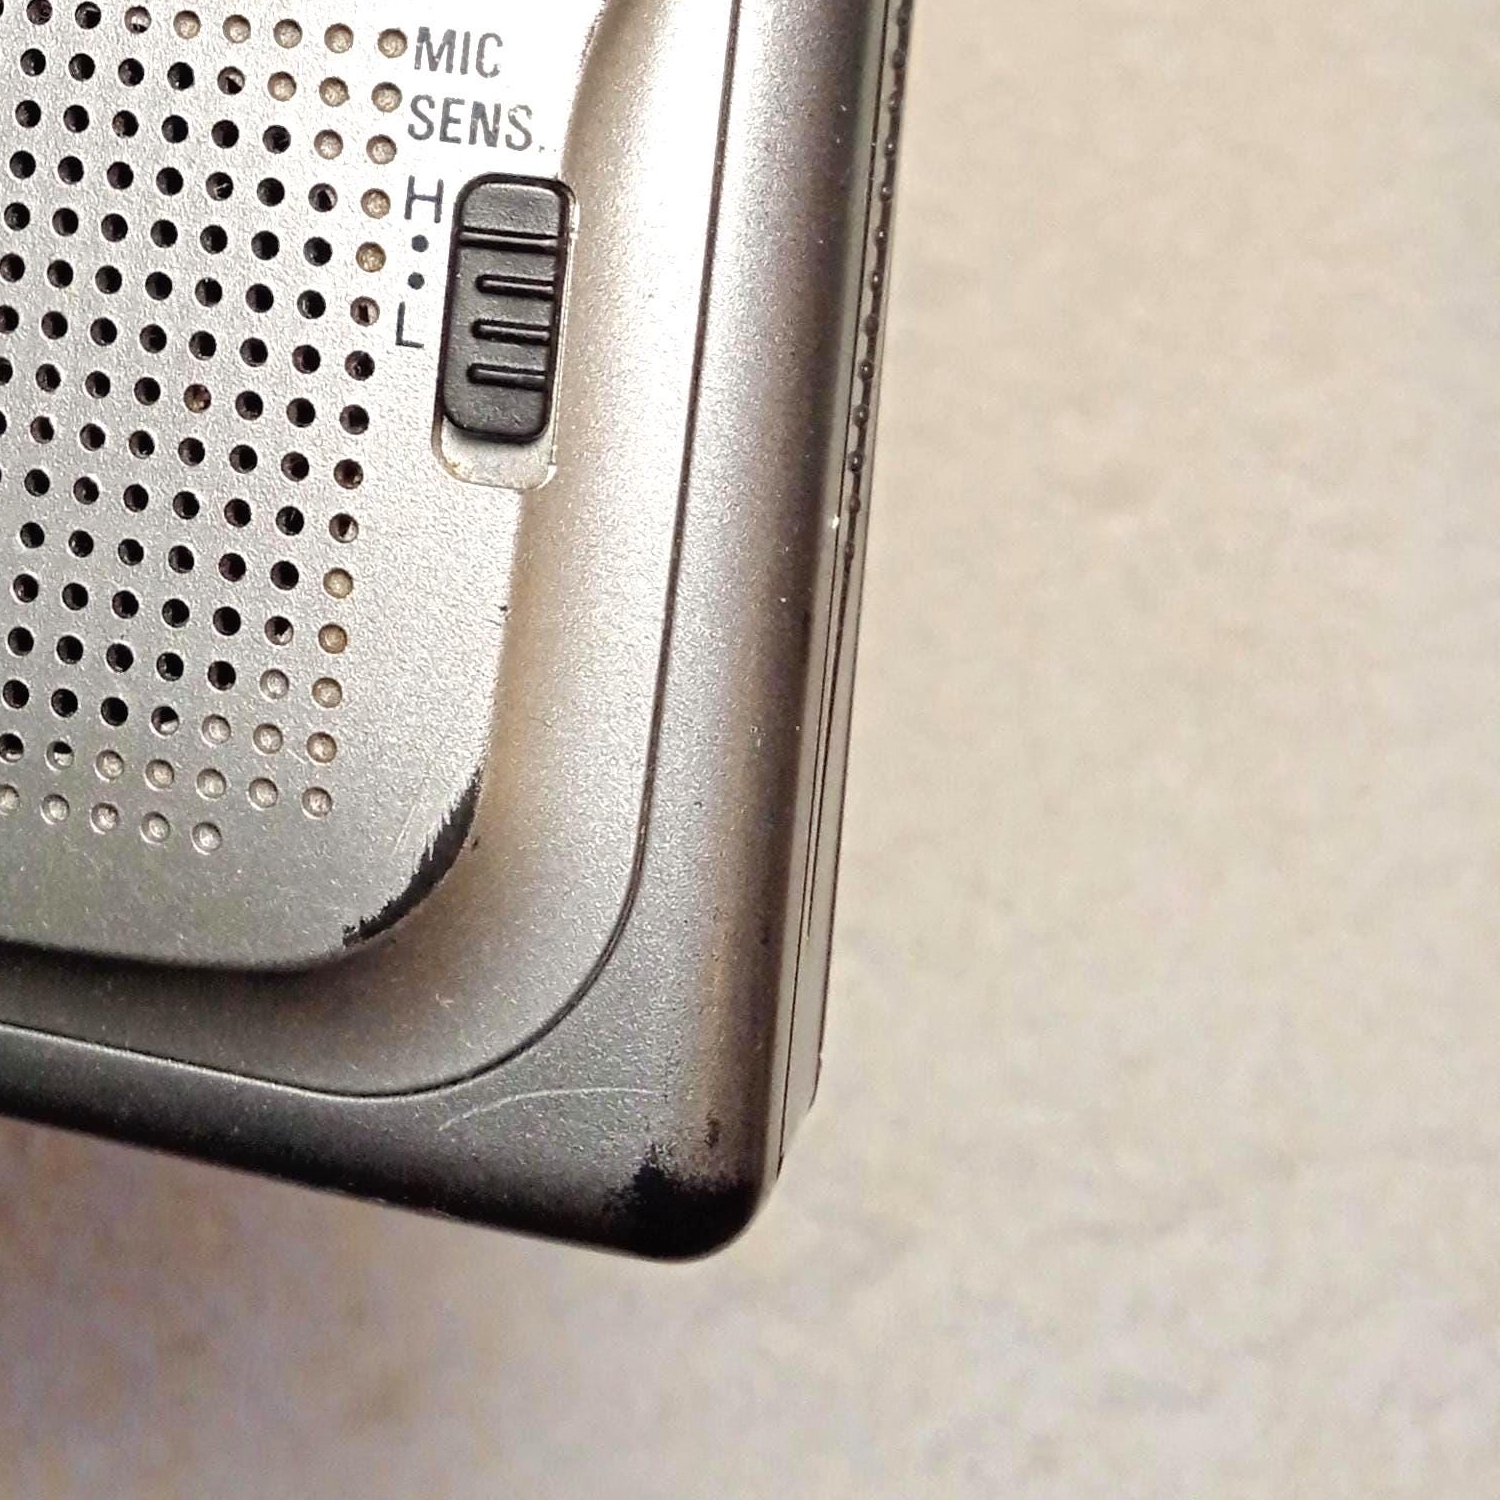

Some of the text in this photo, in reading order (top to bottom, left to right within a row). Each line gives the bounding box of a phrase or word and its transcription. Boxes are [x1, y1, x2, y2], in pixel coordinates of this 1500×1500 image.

[414, 26, 504, 79] MIC
[404, 175, 444, 224] H
[395, 301, 425, 349] L
